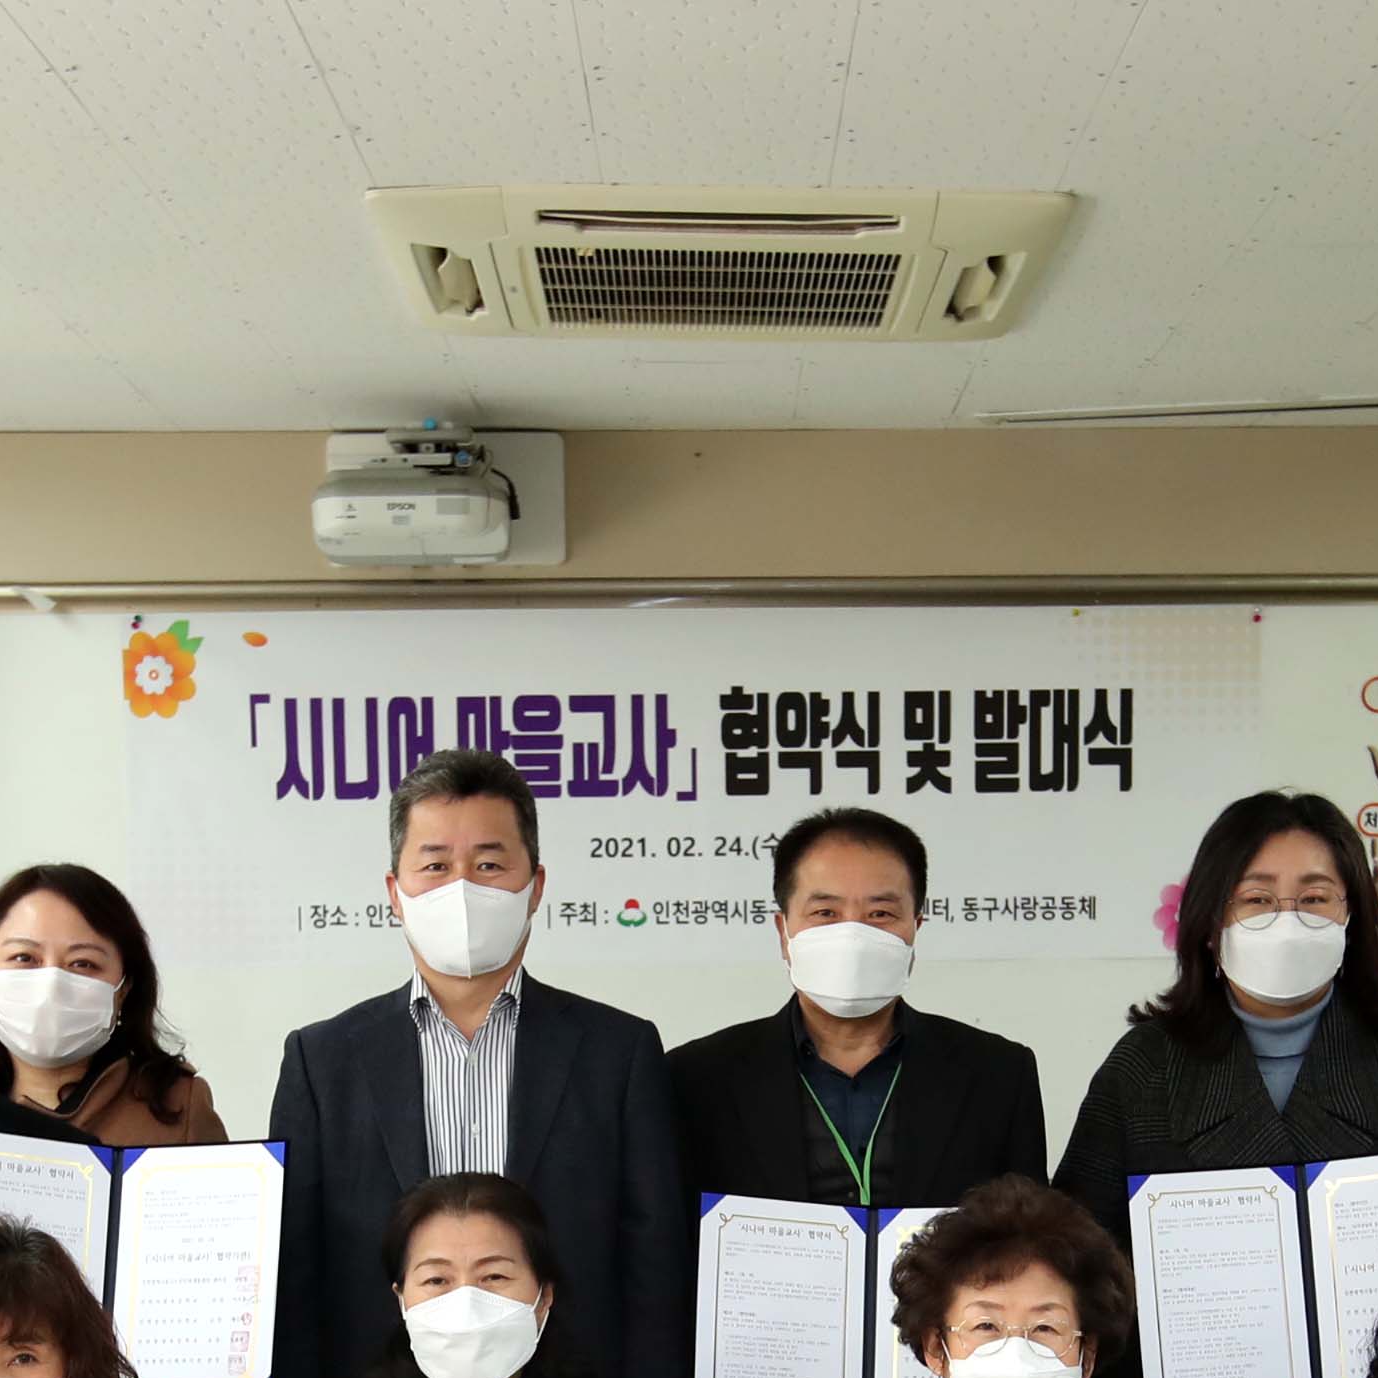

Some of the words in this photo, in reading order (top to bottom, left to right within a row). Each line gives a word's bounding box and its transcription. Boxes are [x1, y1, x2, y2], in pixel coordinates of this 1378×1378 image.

[387, 502, 416, 512] EPSON
[719, 686, 881, 797] 협약식
[902, 690, 954, 794] 및
[972, 688, 1135, 794] 발대식
[590, 837, 657, 858] 2021.
[666, 837, 703, 857] 02.
[310, 904, 348, 928] 장소
[559, 901, 597, 926] 주최
[961, 895, 1097, 922] 동구사랑공동체
